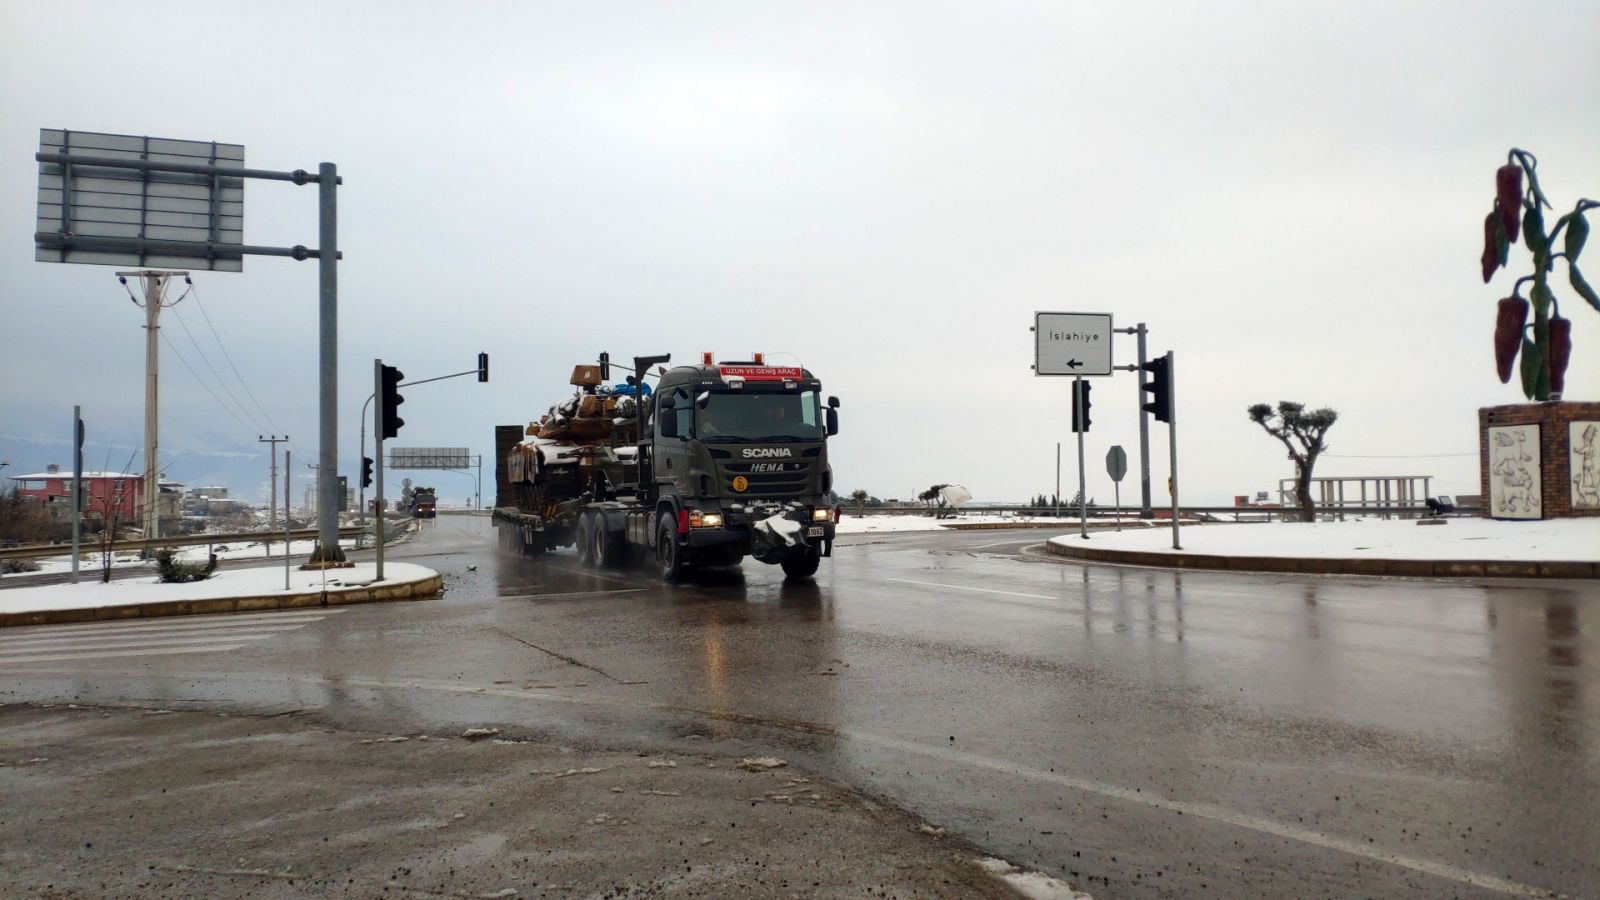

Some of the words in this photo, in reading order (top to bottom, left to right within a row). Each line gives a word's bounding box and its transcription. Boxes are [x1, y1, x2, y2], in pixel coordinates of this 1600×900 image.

[1049, 329, 1099, 343] İslahiye
[742, 448, 792, 458] SCANIA
[750, 463, 784, 472] HEMA
